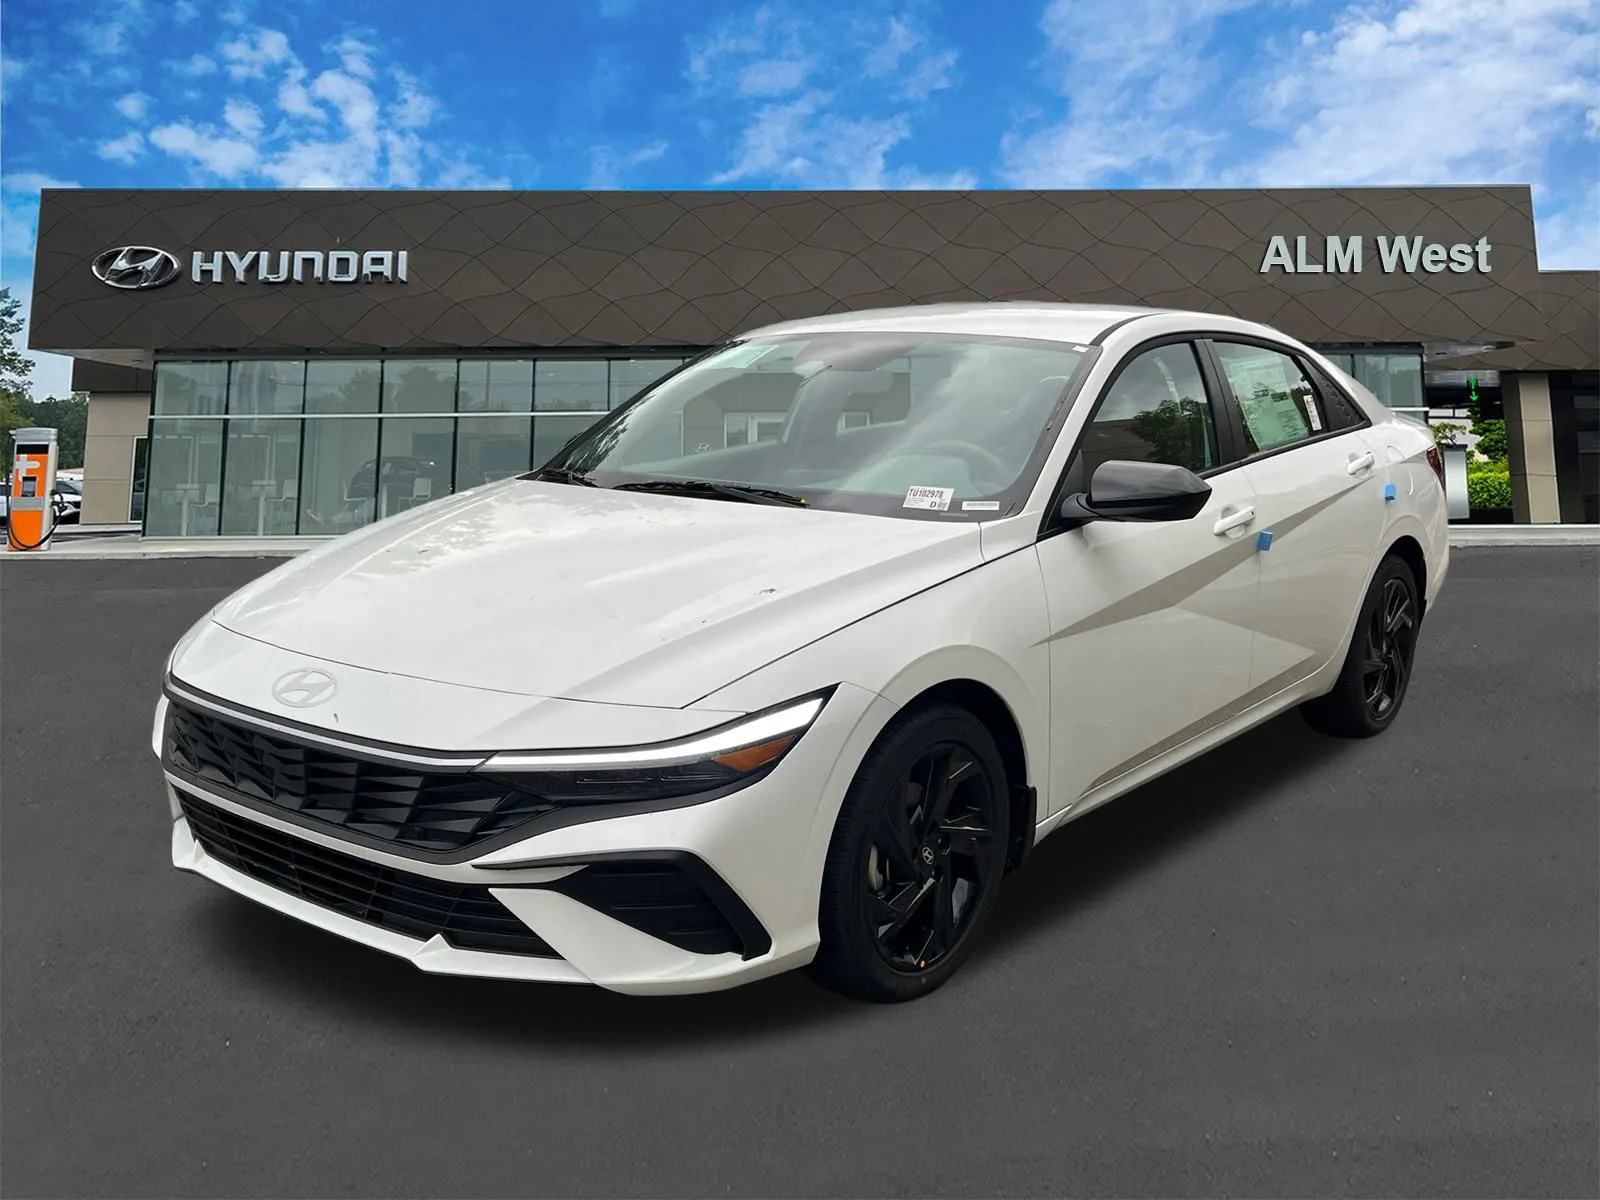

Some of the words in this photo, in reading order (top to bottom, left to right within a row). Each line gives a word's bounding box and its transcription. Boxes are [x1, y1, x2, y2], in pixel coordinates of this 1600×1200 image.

[191, 250, 409, 283] HYUNDAI
[1260, 235, 1363, 273] ALM
[1377, 235, 1492, 273] West
